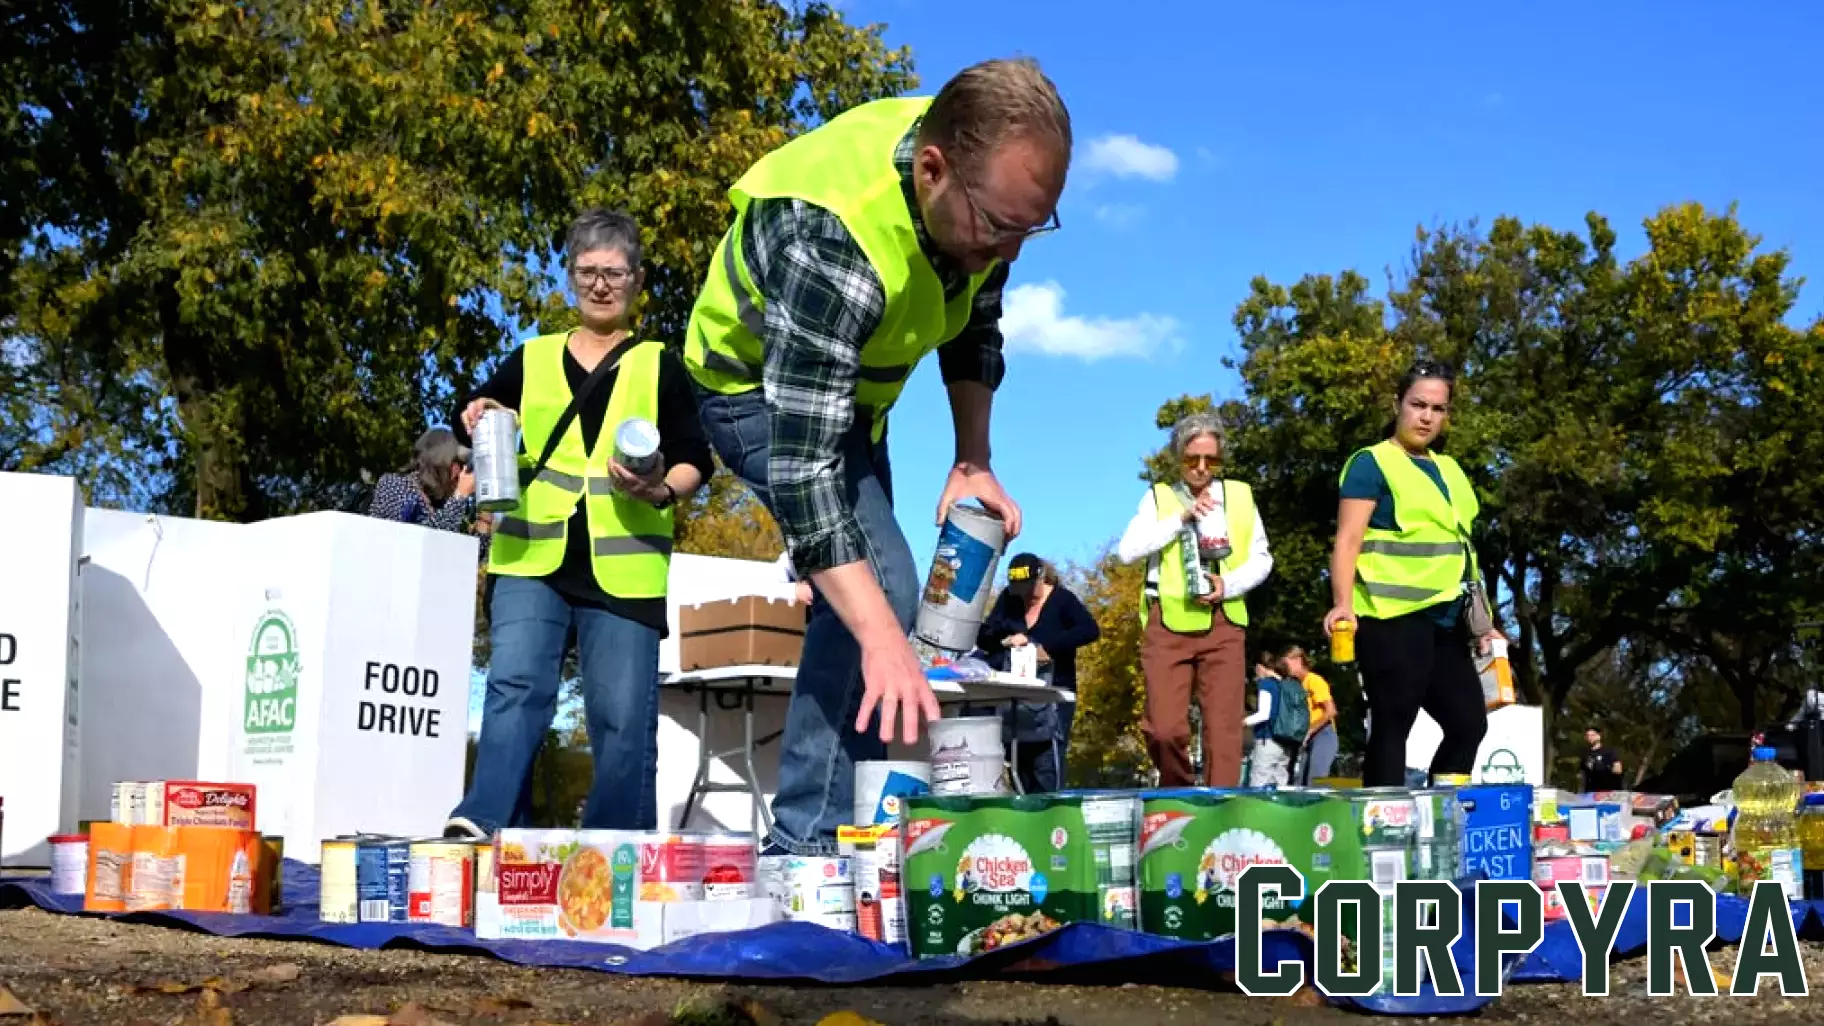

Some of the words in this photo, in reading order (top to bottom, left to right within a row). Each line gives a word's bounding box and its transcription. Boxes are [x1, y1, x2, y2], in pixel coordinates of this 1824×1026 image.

[365, 662, 439, 698] FOOD
[247, 697, 294, 728] AFAC
[358, 702, 441, 739] DRIVE
[1500, 791, 1511, 811] 6
[976, 856, 1028, 875] Chicken
[502, 866, 553, 895] simply
[1005, 893, 1030, 905] LIGHT
